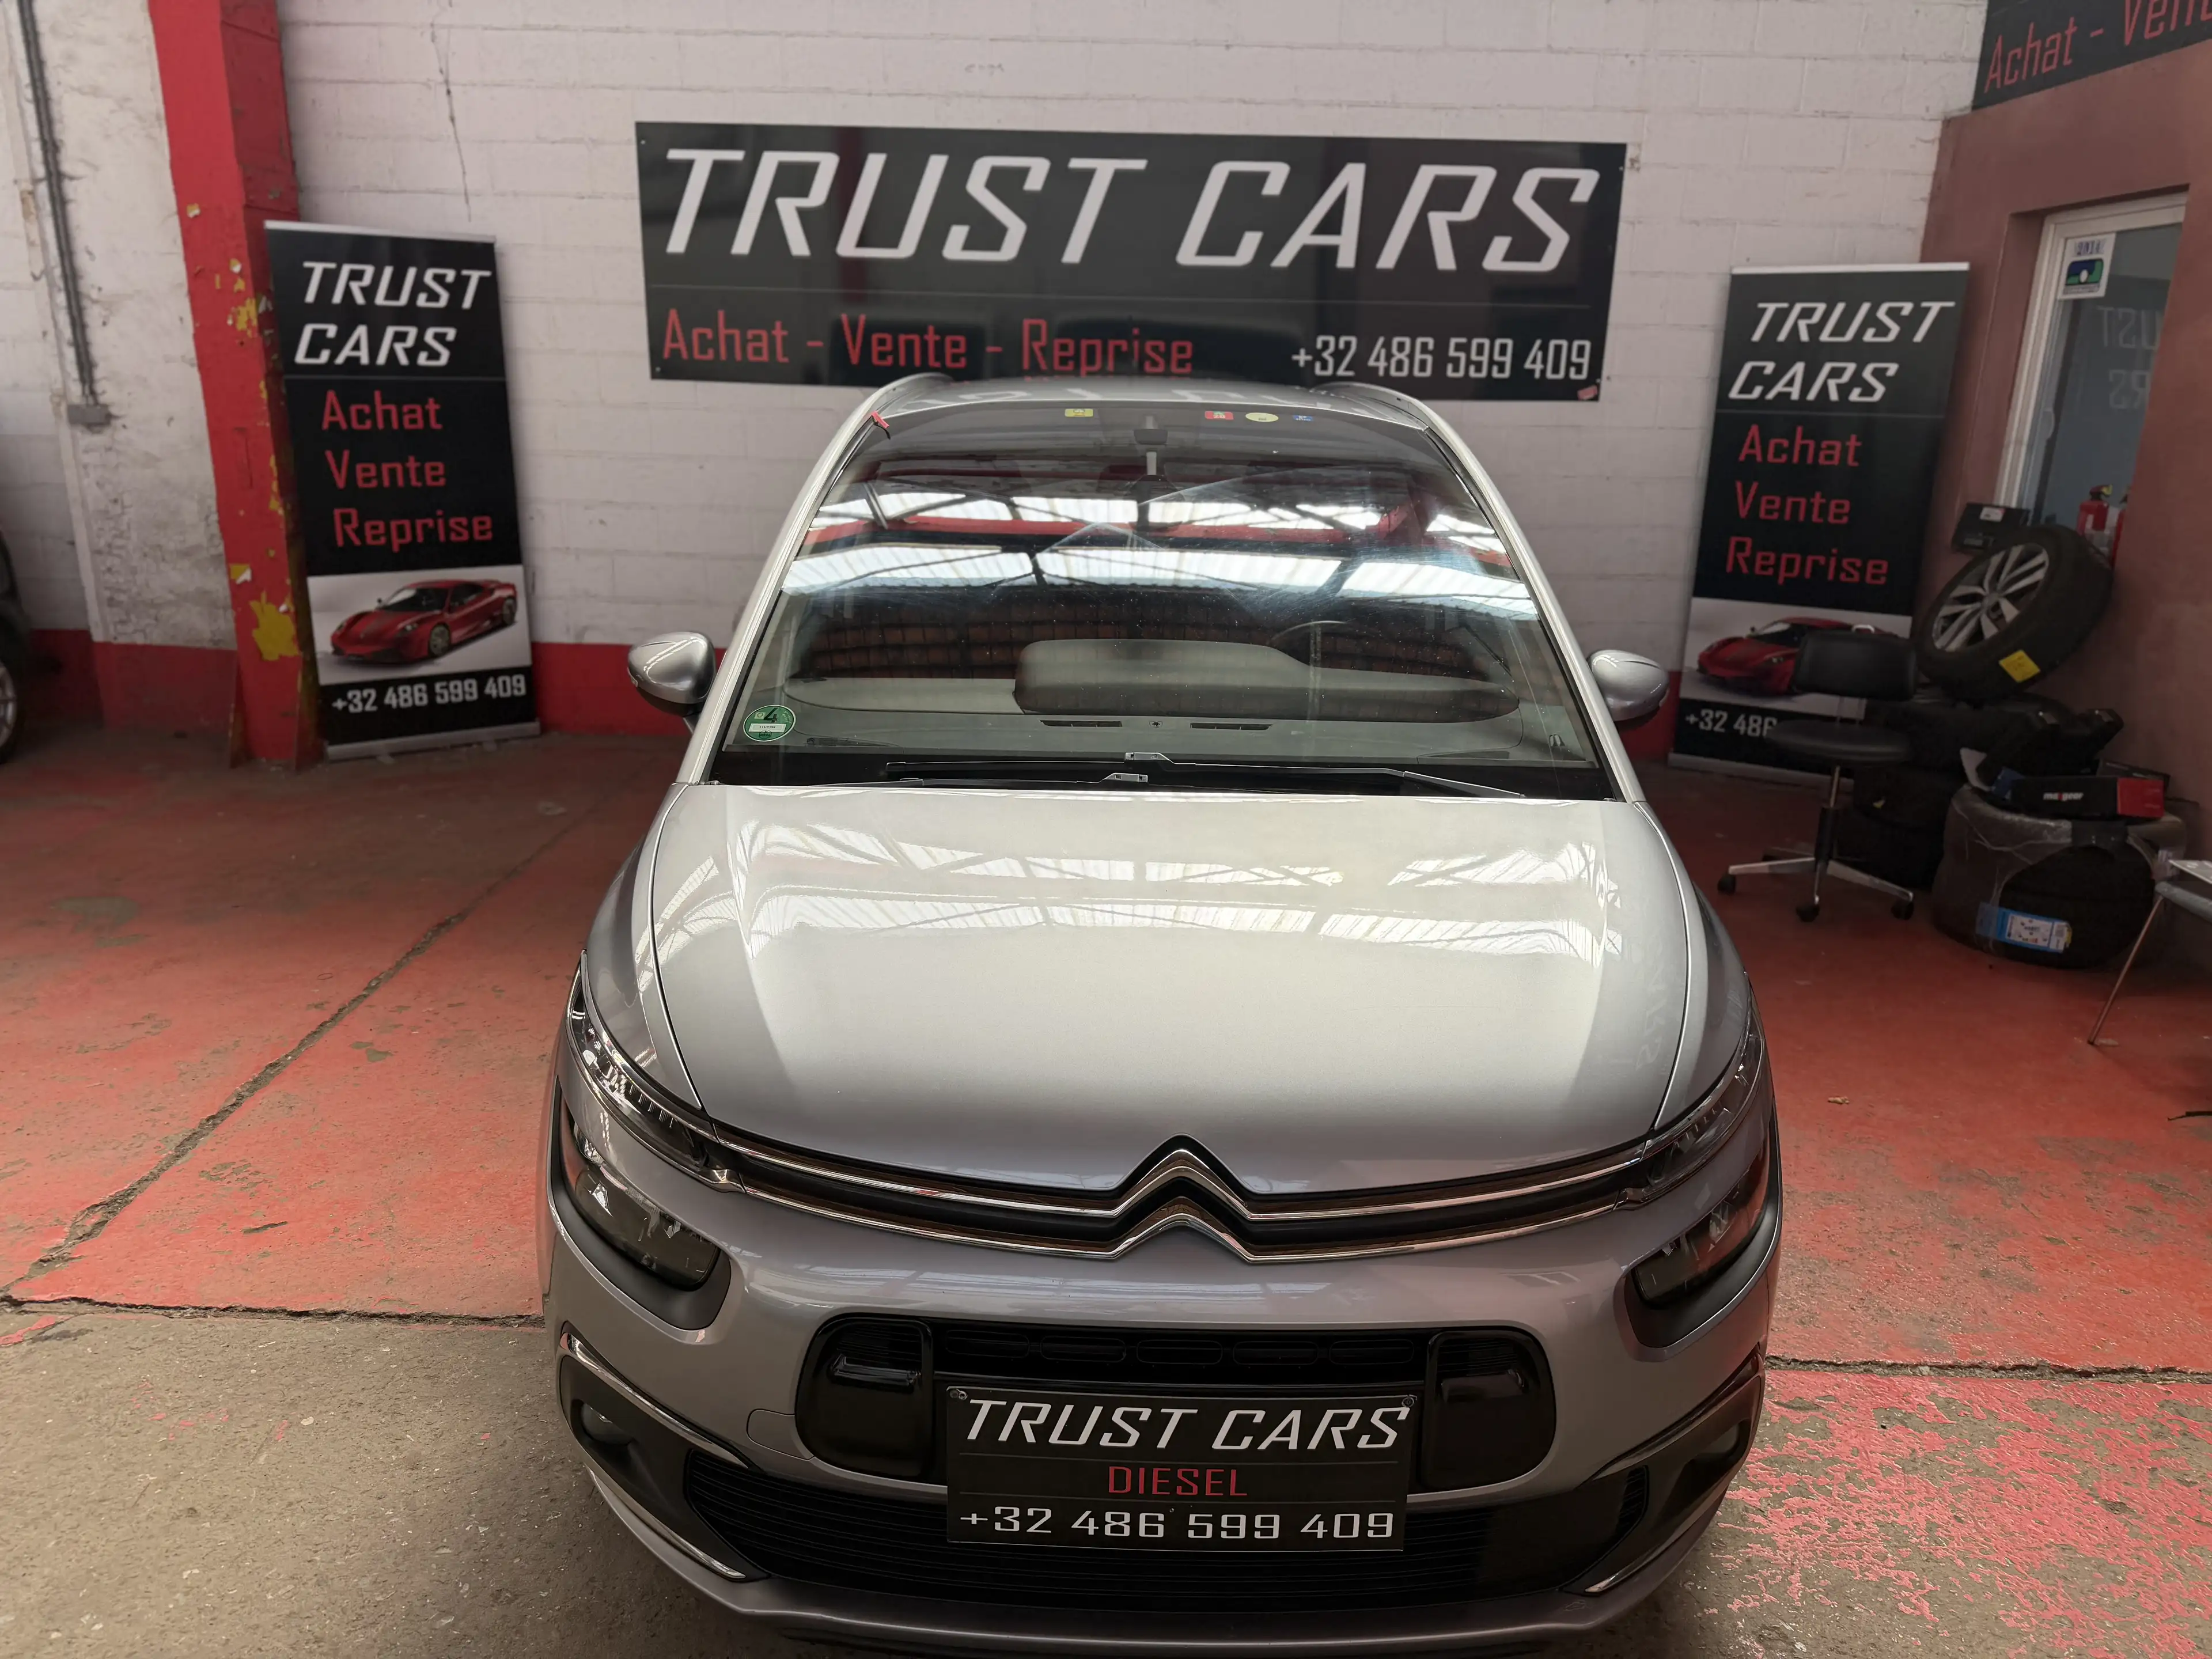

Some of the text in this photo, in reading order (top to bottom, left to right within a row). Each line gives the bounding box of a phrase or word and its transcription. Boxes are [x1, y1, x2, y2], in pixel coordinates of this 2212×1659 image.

[1984, 17, 2077, 94] Achat
[665, 148, 1600, 272] TRUST CARS
[302, 260, 492, 309] TRUST
[663, 308, 789, 363] Achat
[841, 313, 967, 369] Vente
[1021, 317, 1194, 376] Reprise
[1751, 301, 1956, 343] TRUST
[294, 323, 457, 367] CARS
[1291, 335, 1592, 381] +32 486 599 409
[1728, 360, 1900, 403] CARS
[321, 390, 443, 431] Achat
[1738, 423, 1862, 467] Achat
[324, 449, 446, 490] Vente
[1736, 480, 1851, 525] Vente
[333, 507, 493, 554] Reprise
[1725, 536, 1889, 586] Reprise
[331, 673, 527, 714] +32 486 599 409
[764, 707, 779, 723] 4
[1685, 708, 1729, 733] +32
[967, 1399, 1410, 1450] TRUST CARS
[1108, 1465, 1248, 1497] DIESEL
[959, 1506, 1395, 1540] +32 486 599 409
